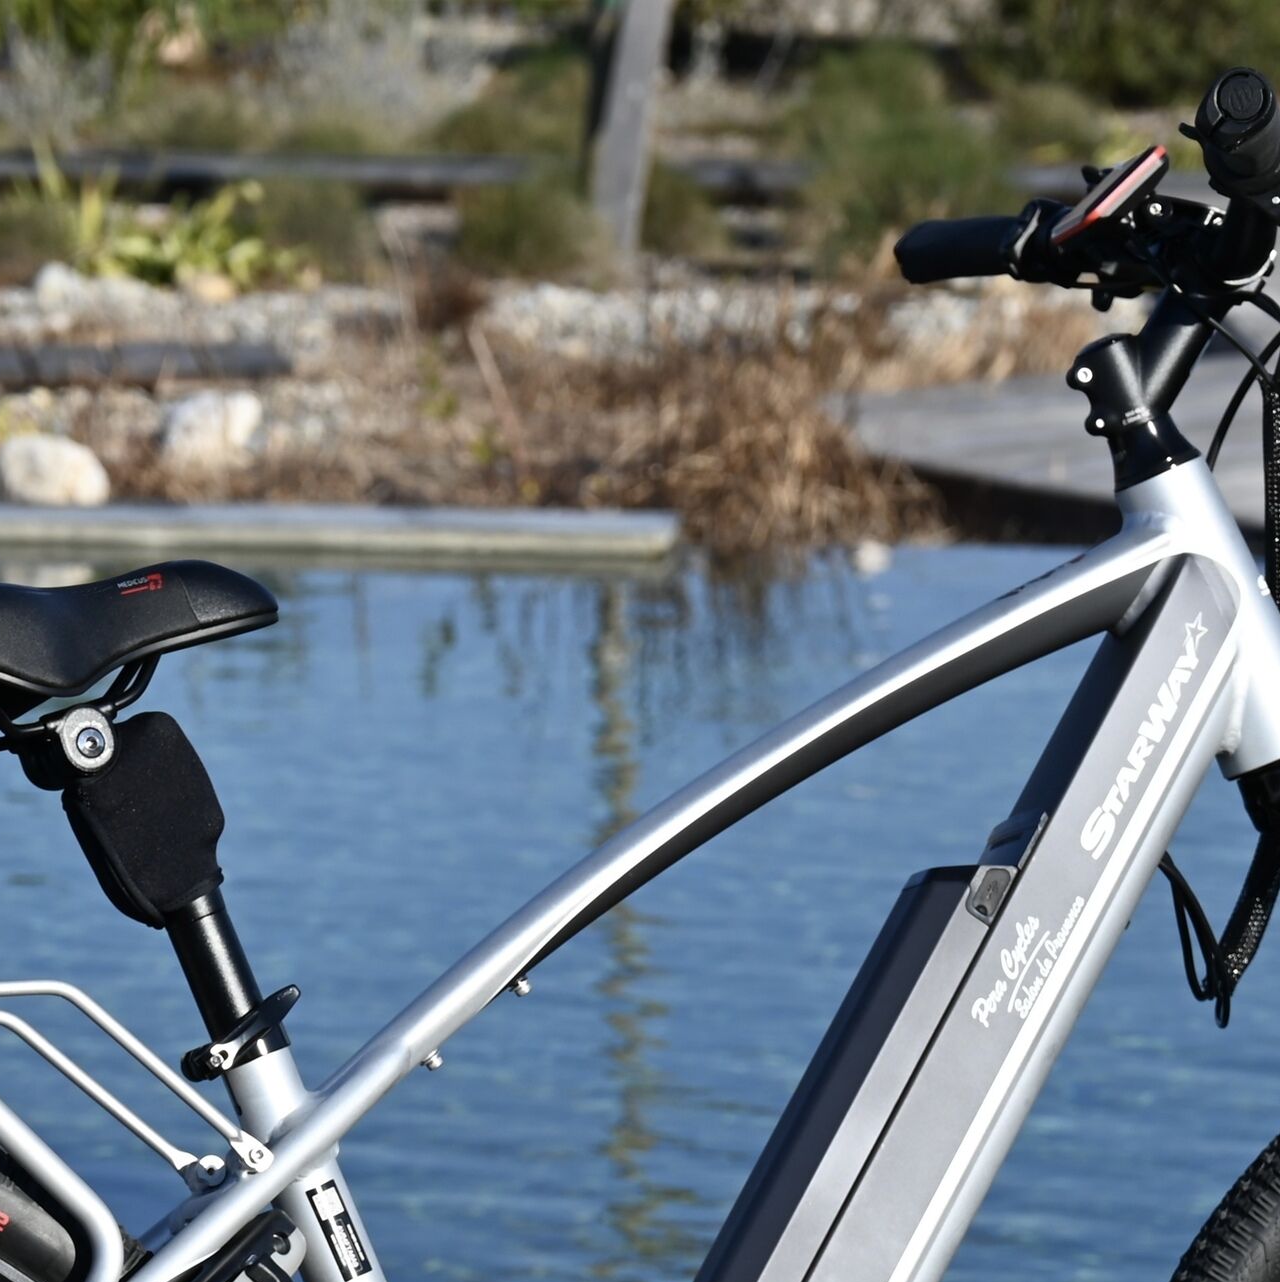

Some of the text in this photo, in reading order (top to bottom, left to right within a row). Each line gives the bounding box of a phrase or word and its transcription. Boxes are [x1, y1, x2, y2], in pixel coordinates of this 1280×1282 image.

[1080, 633, 1204, 860] STARWAY
[1000, 915, 1040, 980] Cycles
[1044, 895, 1085, 960] Provence
[1036, 958, 1053, 978] de
